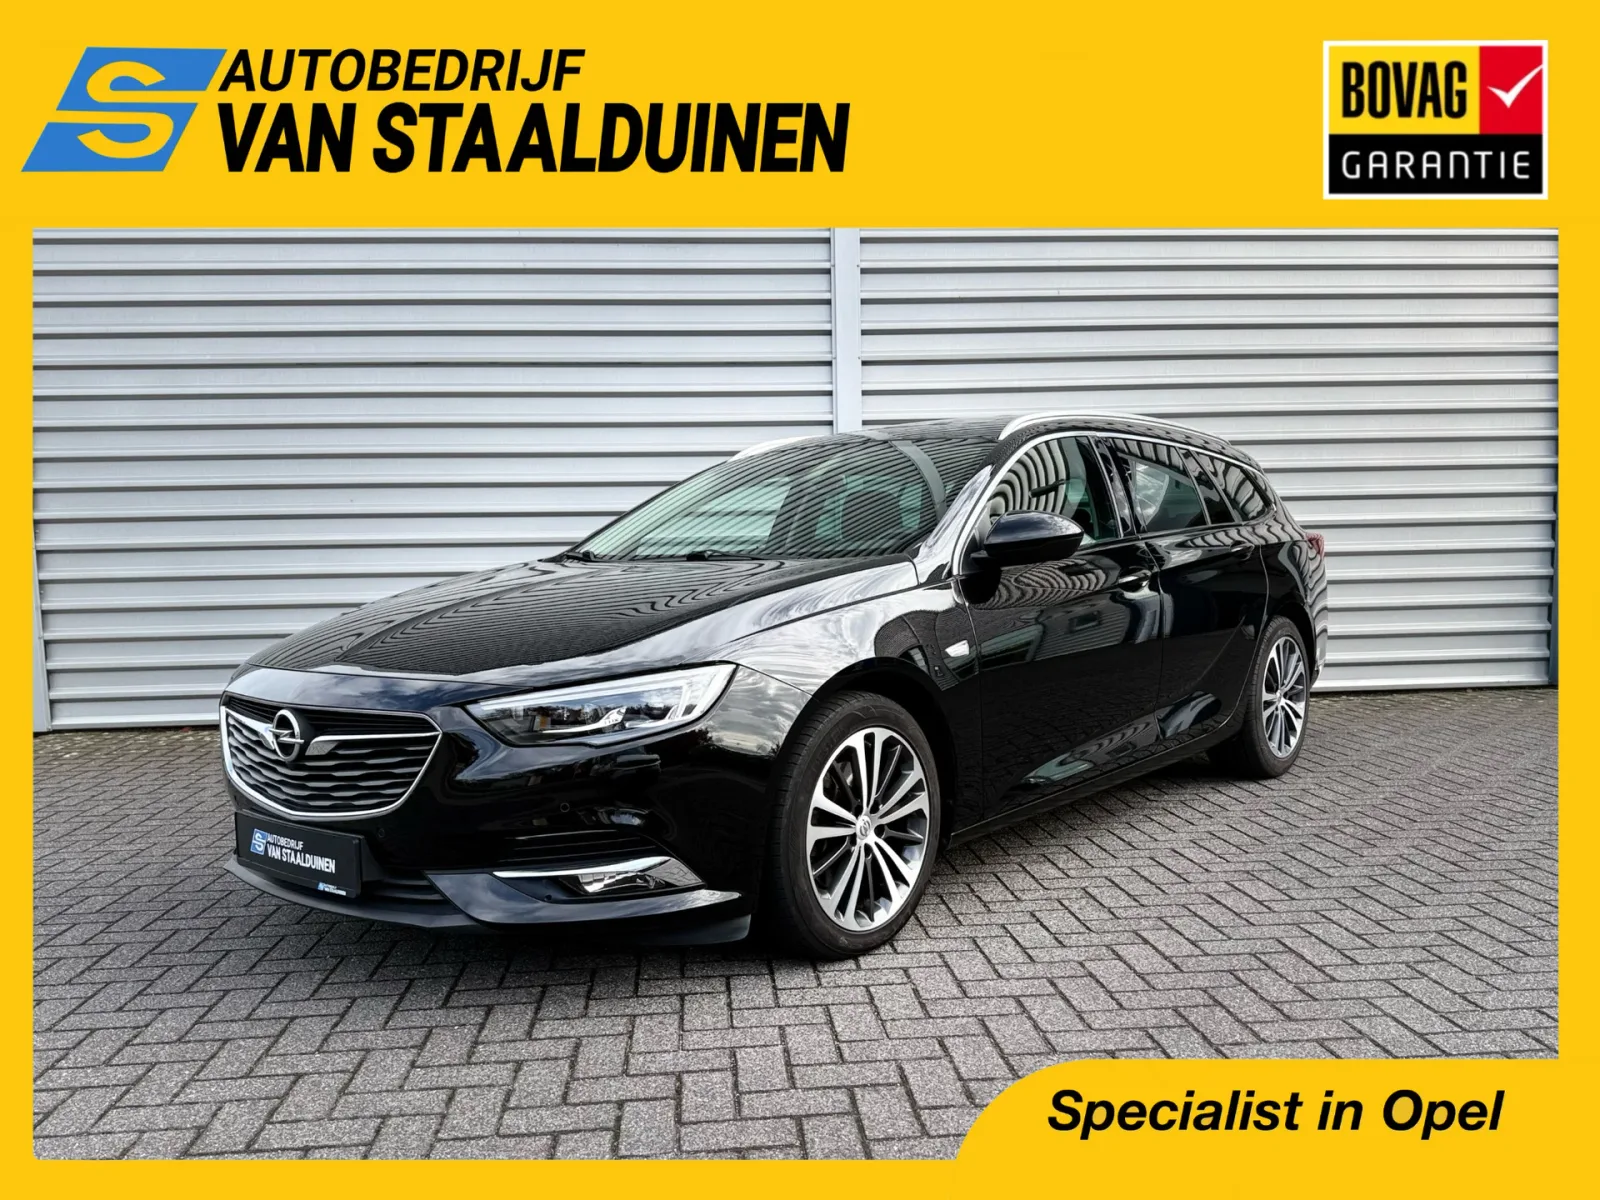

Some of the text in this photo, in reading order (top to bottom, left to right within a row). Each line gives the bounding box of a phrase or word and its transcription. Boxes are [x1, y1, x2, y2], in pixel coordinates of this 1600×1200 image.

[266, 833, 304, 850] AUTOBEDRIJF
[266, 843, 336, 873] VAN STAALDUINEN
